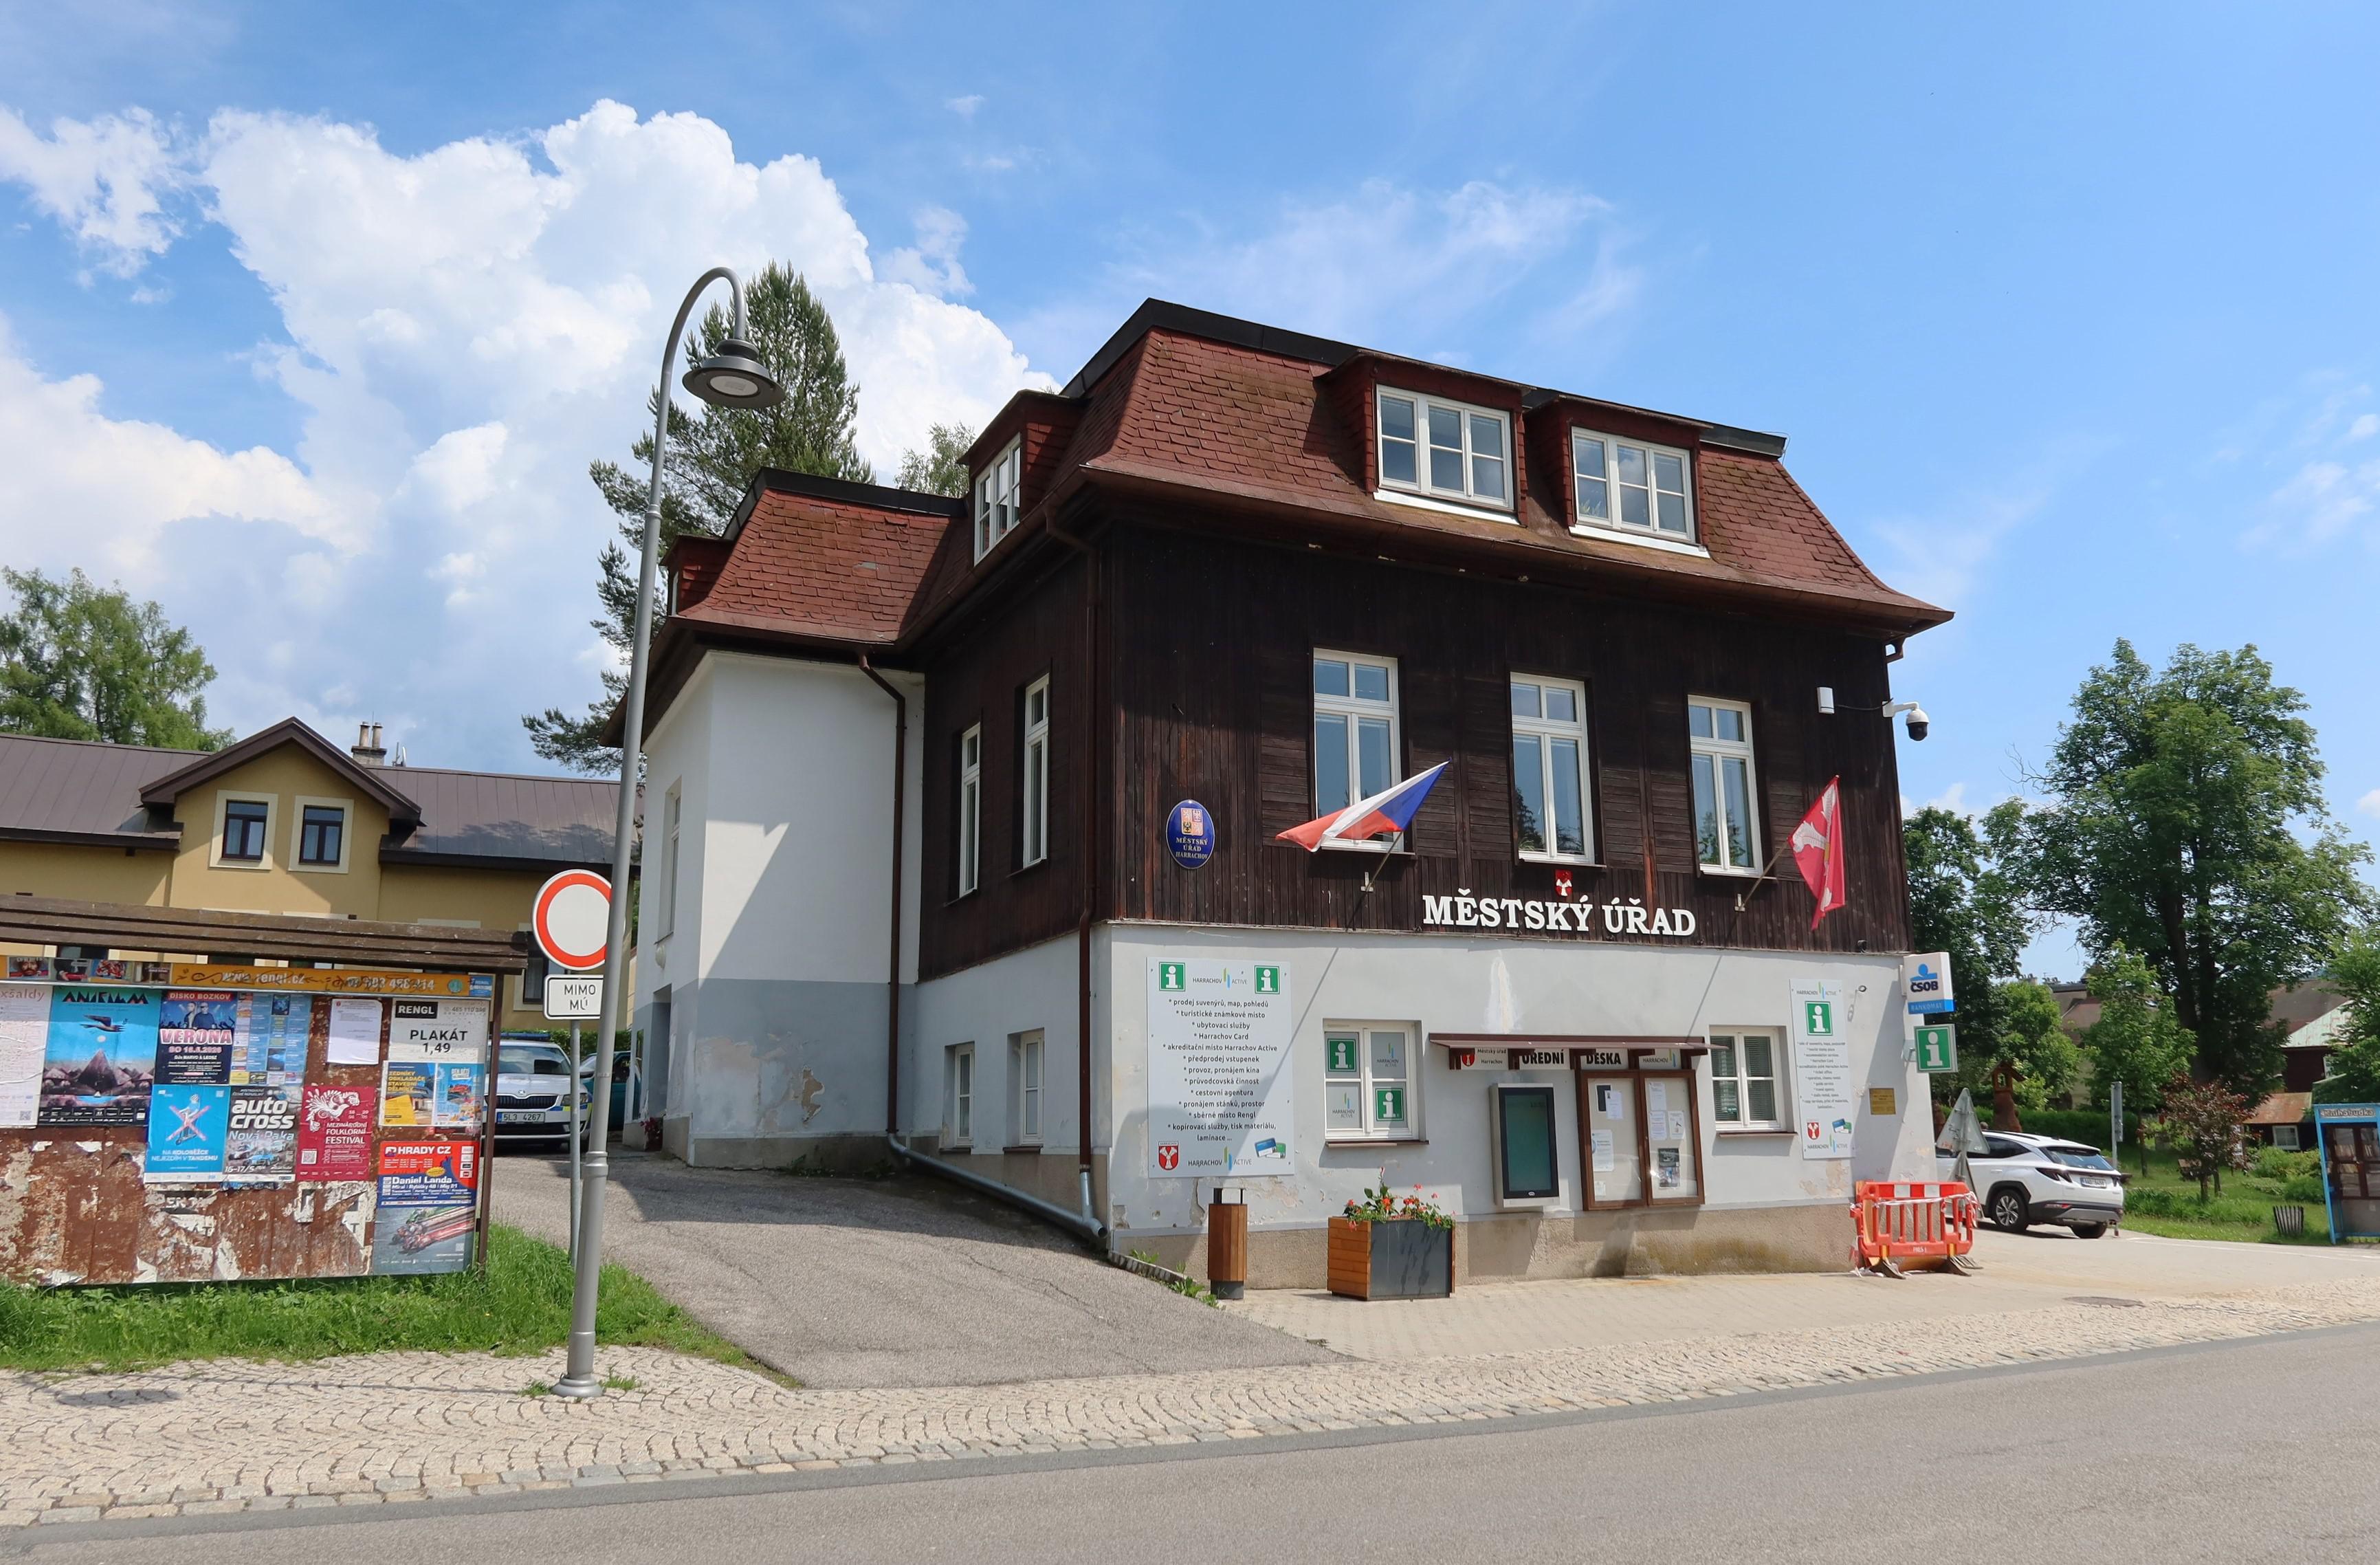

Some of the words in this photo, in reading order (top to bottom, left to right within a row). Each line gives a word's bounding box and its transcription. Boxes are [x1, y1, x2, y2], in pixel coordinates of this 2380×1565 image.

[1176, 837, 1208, 845] MĚSTSKÝ
[1422, 887, 1593, 932] MĚSTSKÝ
[1602, 897, 1696, 937] ÚŘAD
[564, 985, 595, 995] MIMO
[1910, 981, 1939, 993] ČSOB
[570, 996, 588, 1011] MÚ
[1196, 999, 1226, 1007] suvenýrů,
[399, 1005, 434, 1015] RENGL
[1229, 1022, 1250, 1030] služby
[159, 1029, 232, 1045] VERONA
[410, 1028, 467, 1041] PLAKÁT
[423, 1042, 451, 1055] 1,49
[1587, 1052, 1621, 1064] DESKA
[232, 1097, 287, 1114] auto
[1184, 1100, 1214, 1108] pronájem
[1237, 1111, 1257, 1119] Rengl
[231, 1115, 296, 1129] cross
[1173, 1124, 1206, 1132] kopírovací
[228, 1130, 259, 1140] Nová
[261, 1130, 294, 1141] Paka
[324, 1136, 365, 1144] FESTIVAL
[397, 1146, 435, 1154] HRADY
[437, 1146, 452, 1154] CZ
[392, 1176, 421, 1184] Daniel
